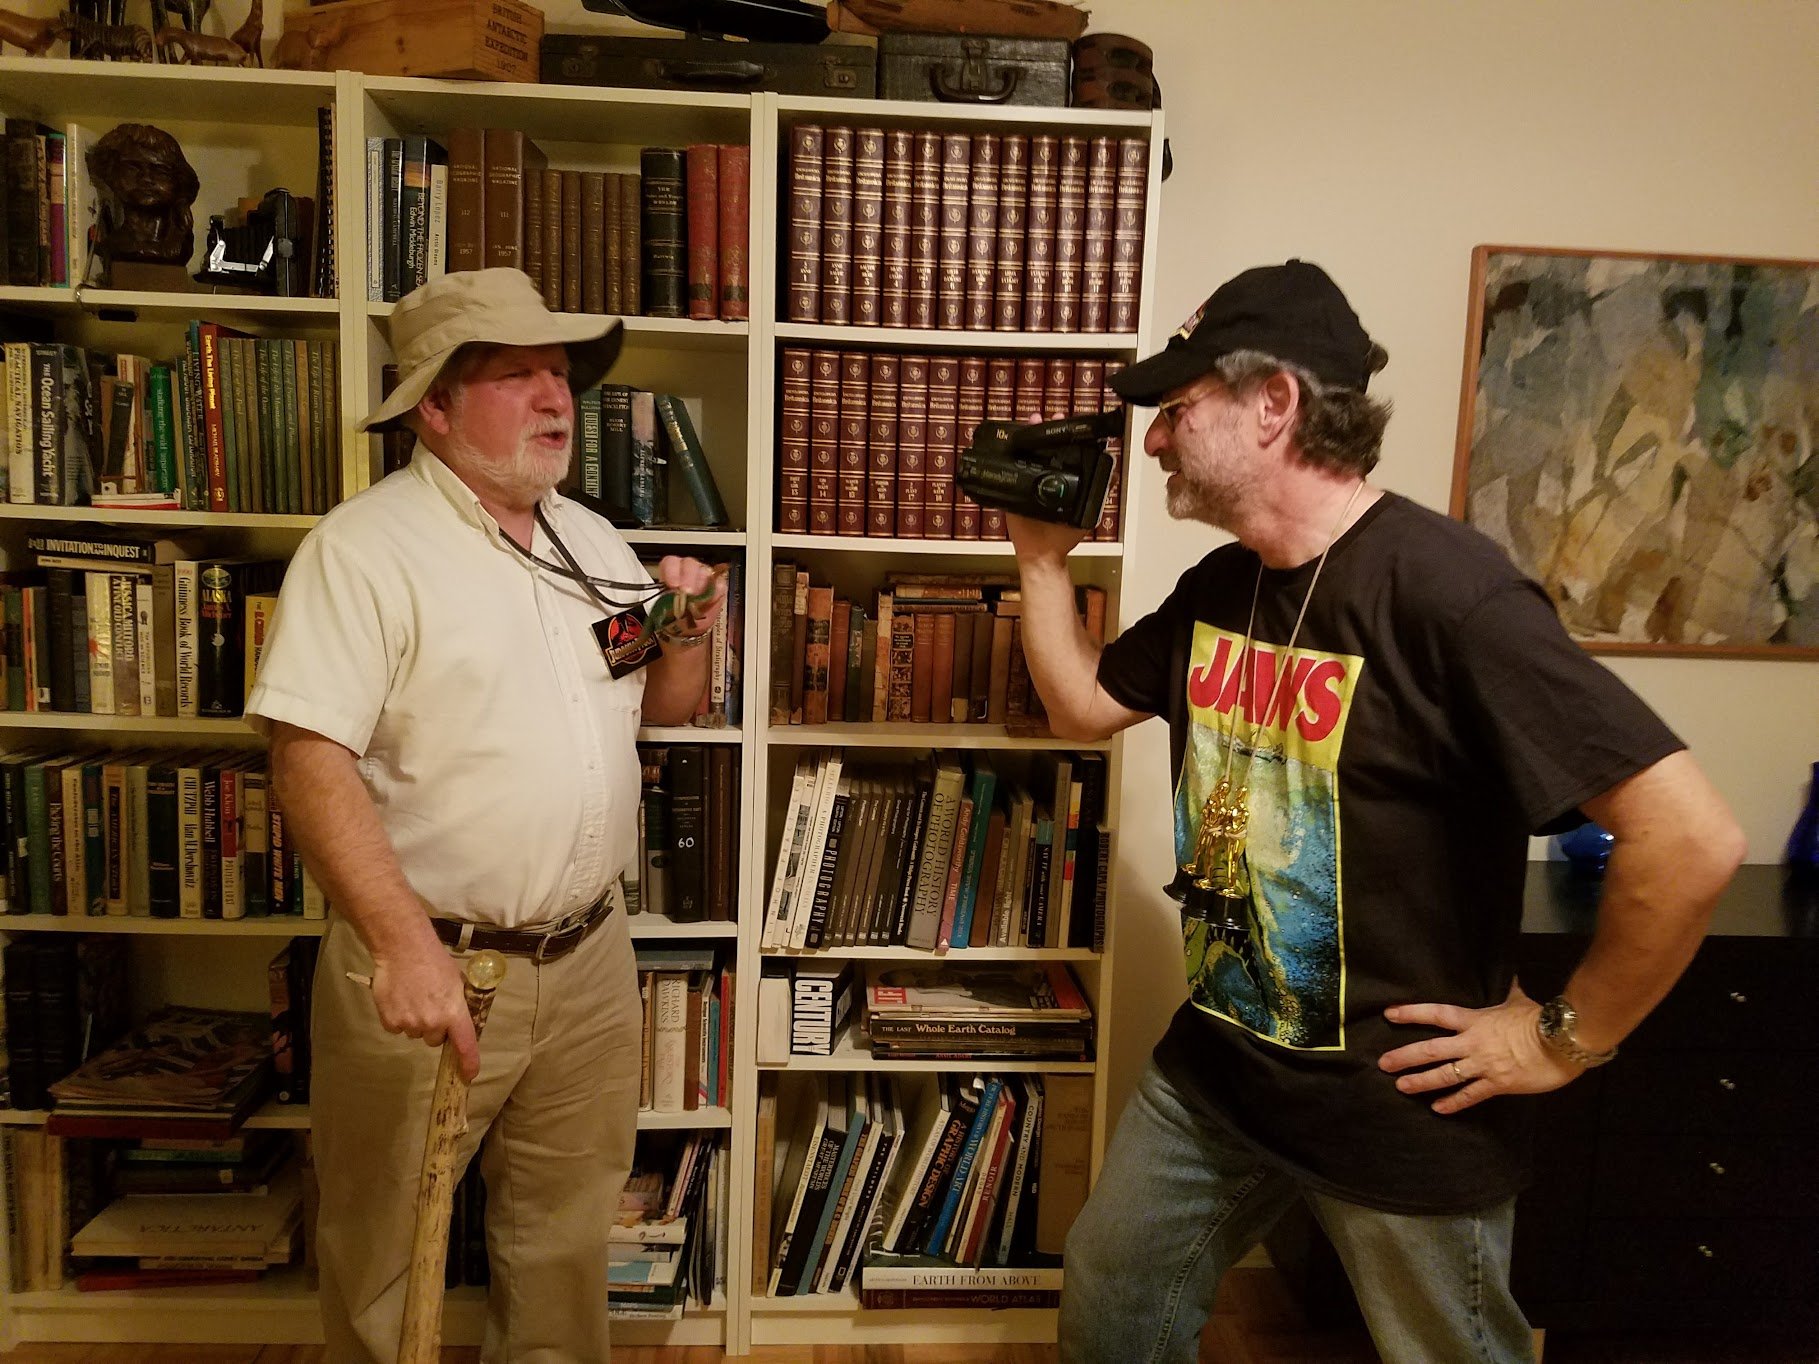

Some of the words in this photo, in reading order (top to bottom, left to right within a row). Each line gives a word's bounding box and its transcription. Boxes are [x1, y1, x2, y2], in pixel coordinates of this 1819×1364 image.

[487, 19, 528, 44] ANTARCTIC
[485, 36, 528, 61] EXPEDITION
[434, 179, 444, 200] Barry
[409, 207, 417, 227] Edwin
[416, 192, 424, 225] BEYOND
[434, 202, 443, 224] Lopez
[416, 228, 424, 242] THE
[407, 228, 417, 269] Mickleburgh
[415, 243, 423, 274] FROZEN
[205, 335, 213, 353] Earth
[271, 350, 279, 361] The
[43, 363, 51, 377] THE
[192, 351, 201, 386] LIVING
[206, 353, 214, 367] The
[259, 362, 267, 375] Life
[271, 363, 279, 375] Life
[312, 351, 320, 364] The
[14, 347, 23, 398] PRACTICAL
[207, 367, 216, 389] Living
[312, 365, 320, 378] Life
[41, 378, 55, 409] Ocean
[156, 388, 166, 418] stalking
[195, 388, 204, 420] WATER
[208, 389, 217, 410] Planet
[14, 401, 23, 455] NAVIGATION
[39, 410, 55, 448] Sailing
[158, 420, 167, 432] the
[313, 410, 321, 424] and
[585, 413, 598, 438] QUEST
[159, 434, 168, 450] wild
[996, 429, 1008, 441] 10x
[1045, 427, 1066, 436] SONY
[586, 439, 598, 453] FOR
[41, 448, 56, 478] Yacht
[46, 538, 95, 554] INVITATION
[104, 544, 140, 559] INQUEST
[121, 580, 133, 618] JESSICA
[178, 577, 192, 615] Guinness
[202, 589, 232, 603] ALASKA
[114, 604, 123, 622] OLD
[715, 608, 724, 636] Principles
[123, 618, 135, 661] MITFORD
[179, 618, 192, 638] Book
[179, 641, 192, 650] of
[180, 651, 193, 674] World
[714, 645, 723, 681] Stratigraphy
[179, 675, 193, 708] Records
[1189, 636, 1346, 742] JAWS
[183, 776, 198, 815] CHUTZPAH
[203, 781, 216, 806] Webb
[223, 779, 234, 793] Joe
[223, 794, 234, 815] Klein
[933, 792, 945, 811] OF
[946, 795, 955, 804] A
[203, 808, 216, 843] Hubbell
[961, 807, 971, 826] Andy
[52, 837, 62, 849] the
[272, 813, 282, 848] STUPID
[679, 837, 695, 848] 60
[936, 807, 955, 856] WORLD
[809, 816, 826, 875] PHOTOGRAPHER
[952, 827, 968, 873] Goldsworthy
[1098, 832, 1110, 863] ROBERT
[52, 851, 63, 882] Courts
[184, 849, 199, 889] Dershowitz
[224, 860, 234, 889] POLITICS
[273, 849, 283, 880] WHITE
[914, 814, 943, 916] PHOTOGRAPHY
[1096, 865, 1108, 885] CAPA
[225, 890, 235, 905] LOST
[274, 880, 284, 902] MEN
[811, 850, 838, 923] PHOTOGRAPHY
[926, 859, 946, 917] HISTORY
[948, 882, 958, 901] TIME
[766, 876, 784, 934] LINHOF
[1003, 891, 1013, 908] light
[998, 909, 1010, 943] Available
[1095, 890, 1107, 946] PHOTOGRAPHS
[660, 978, 671, 1024] DAWKINS
[671, 978, 681, 1023] RICHARD
[793, 980, 833, 1056] CENTURY
[916, 1024, 946, 1034] Whole
[948, 1023, 977, 1034] Earth
[978, 1024, 1016, 1036] Catalog
[1022, 1105, 1035, 1143] COUNTRY
[818, 1138, 829, 1158] GREAT
[822, 1150, 832, 1163] THE
[825, 1140, 834, 1150] OF
[935, 1119, 961, 1169] GRAPHIC
[947, 1131, 965, 1162] HISTORY
[958, 1138, 980, 1175] WORLD
[1019, 1146, 1027, 1161] AND
[809, 1162, 823, 1189] MUSEUMS
[820, 1143, 840, 1190] MASTERPIECES
[918, 1167, 941, 1208] DESIGN
[952, 1177, 967, 1194] ART
[976, 1172, 987, 1196] DEGAS
[982, 1165, 998, 1201] RENOIR
[1011, 1164, 1023, 1197] MODERN
[138, 1223, 265, 1234] ANTARCTICA
[1005, 1212, 1014, 1230] HALL
[913, 1274, 955, 1286] EARTH
[960, 1274, 996, 1286] FROM
[1002, 1274, 1041, 1286] ABOVE
[971, 1294, 1009, 1304] WORLD
[1013, 1295, 1041, 1304] ATLAS
